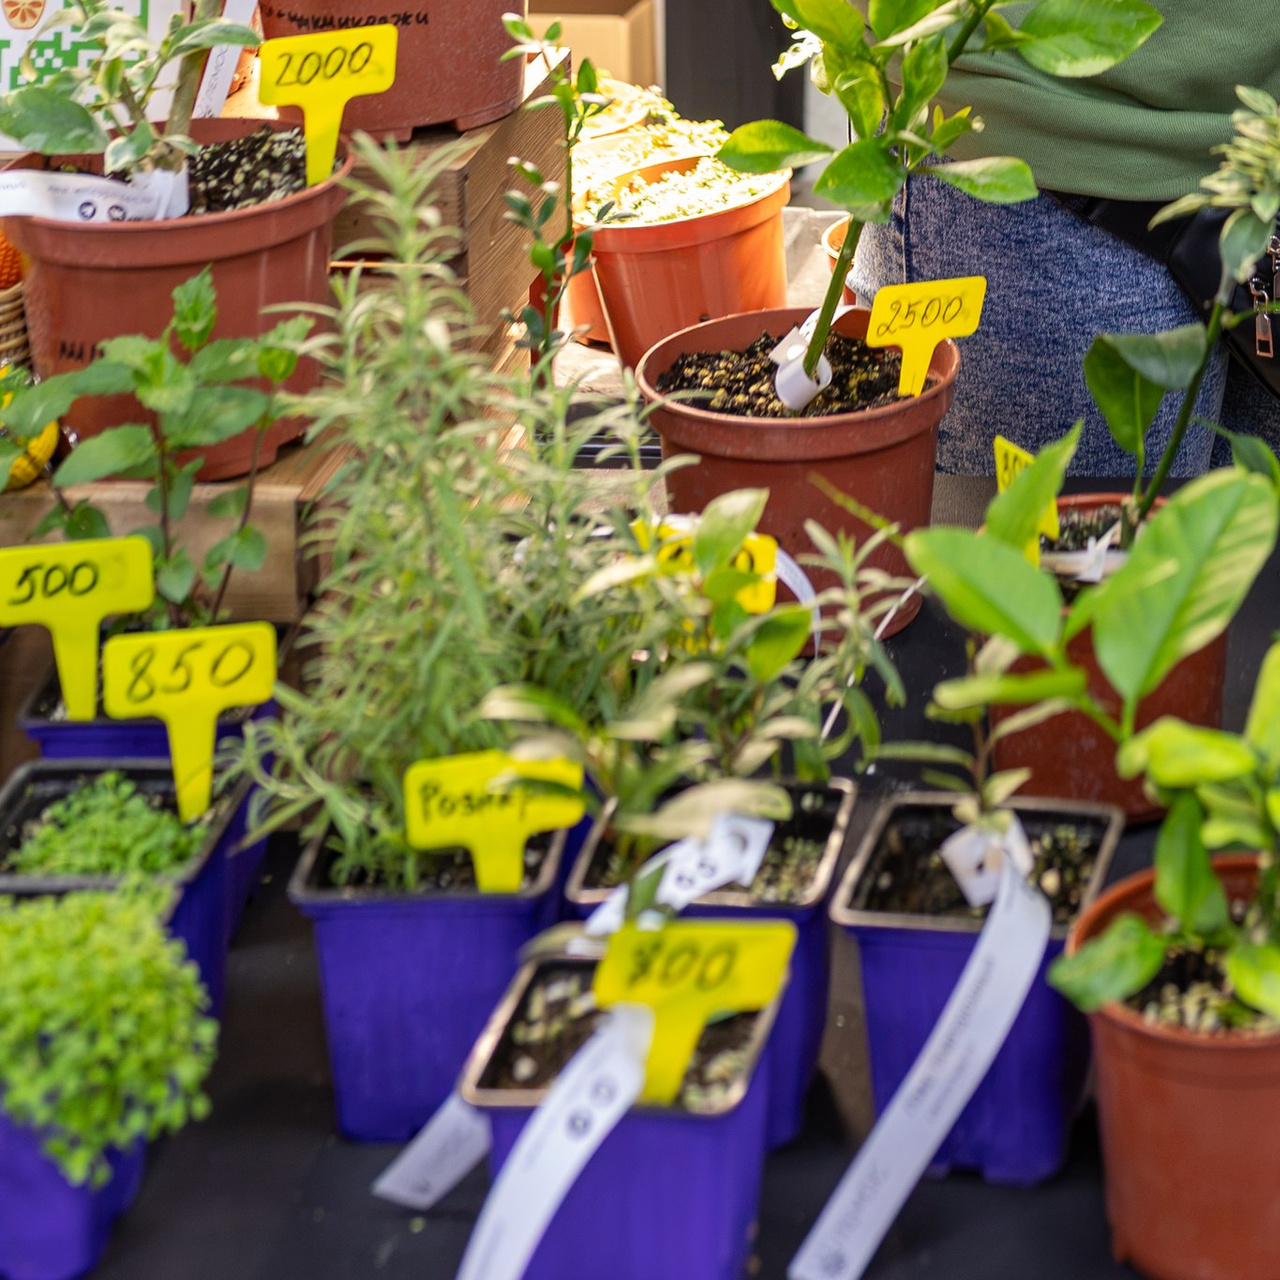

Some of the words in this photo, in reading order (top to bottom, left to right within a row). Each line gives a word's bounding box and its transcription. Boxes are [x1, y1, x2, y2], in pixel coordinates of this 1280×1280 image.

[276, 42, 374, 86] 2000
[877, 296, 963, 337] 2500
[8, 561, 99, 605] 500
[127, 640, 255, 703] 850
